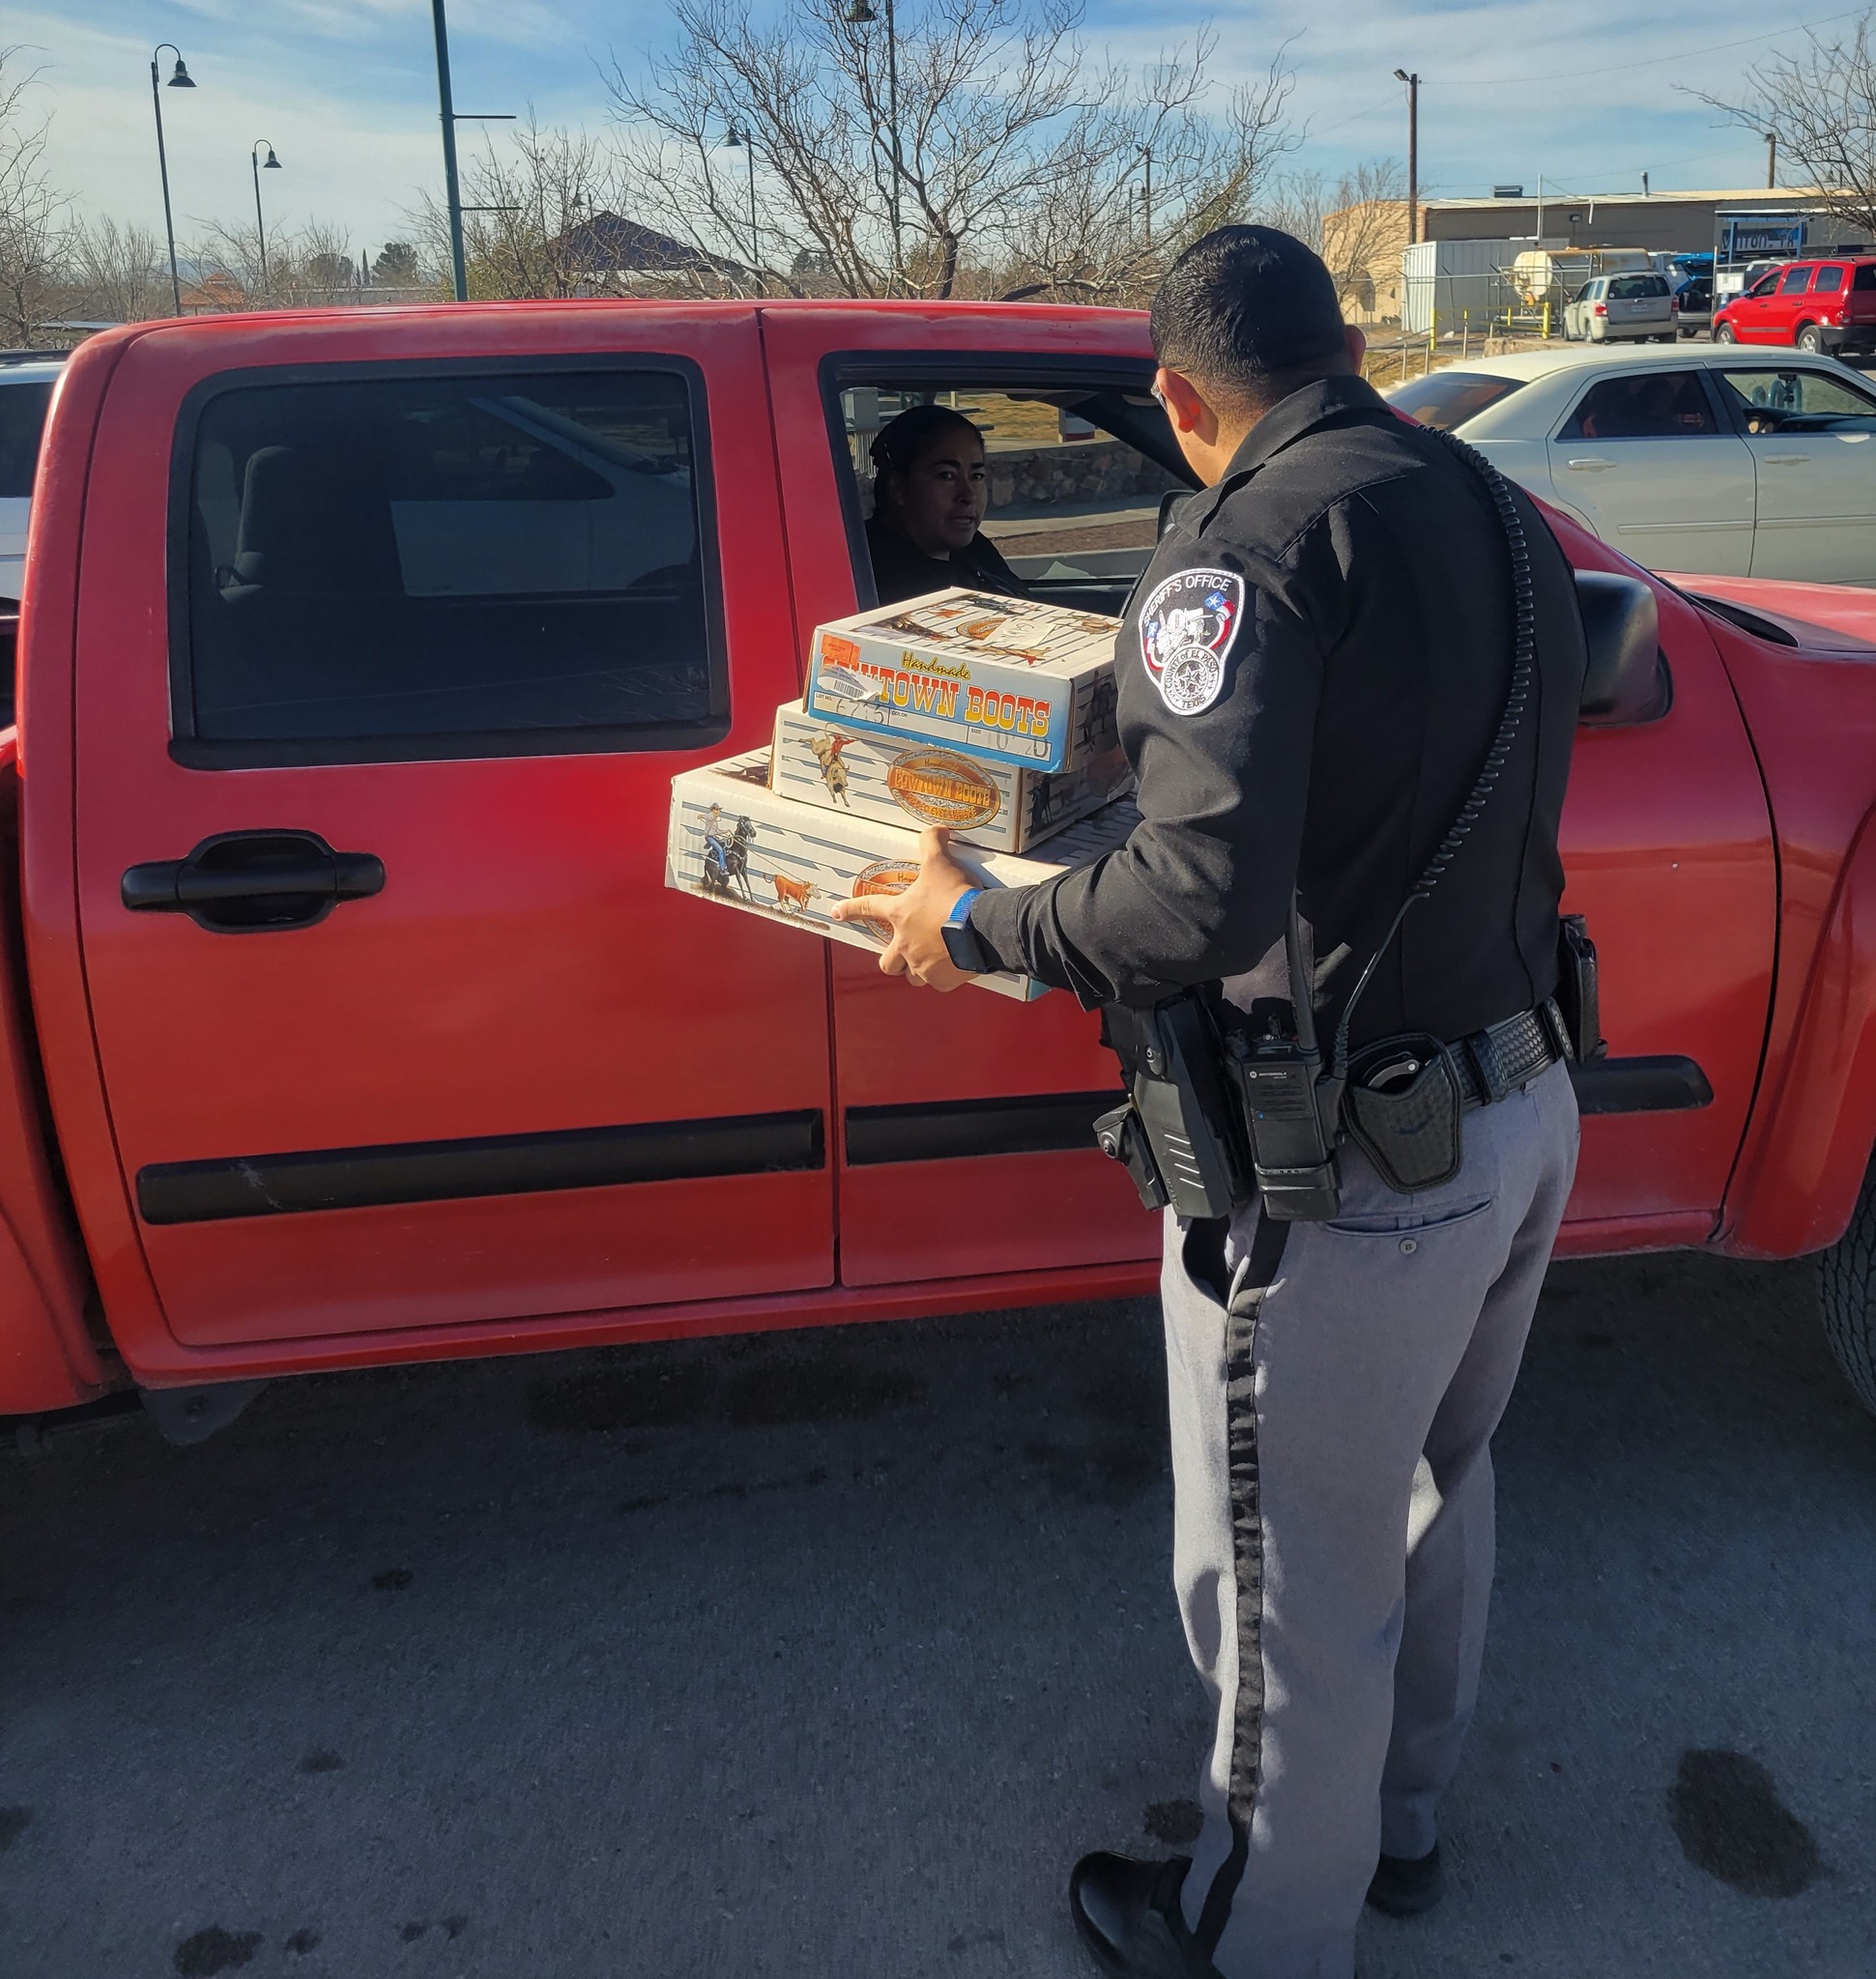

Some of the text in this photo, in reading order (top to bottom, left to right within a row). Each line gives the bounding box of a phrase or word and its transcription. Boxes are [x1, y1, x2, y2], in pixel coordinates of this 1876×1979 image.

[1143, 575, 1232, 627] SHERIFF'S OFFICE
[901, 649, 971, 680] Handmade
[1164, 656, 1181, 689] COUNTY
[822, 654, 1052, 737] TOWN BOOTS
[891, 710, 909, 719] COLOR
[895, 768, 992, 807] COWTOWN BOOTS
